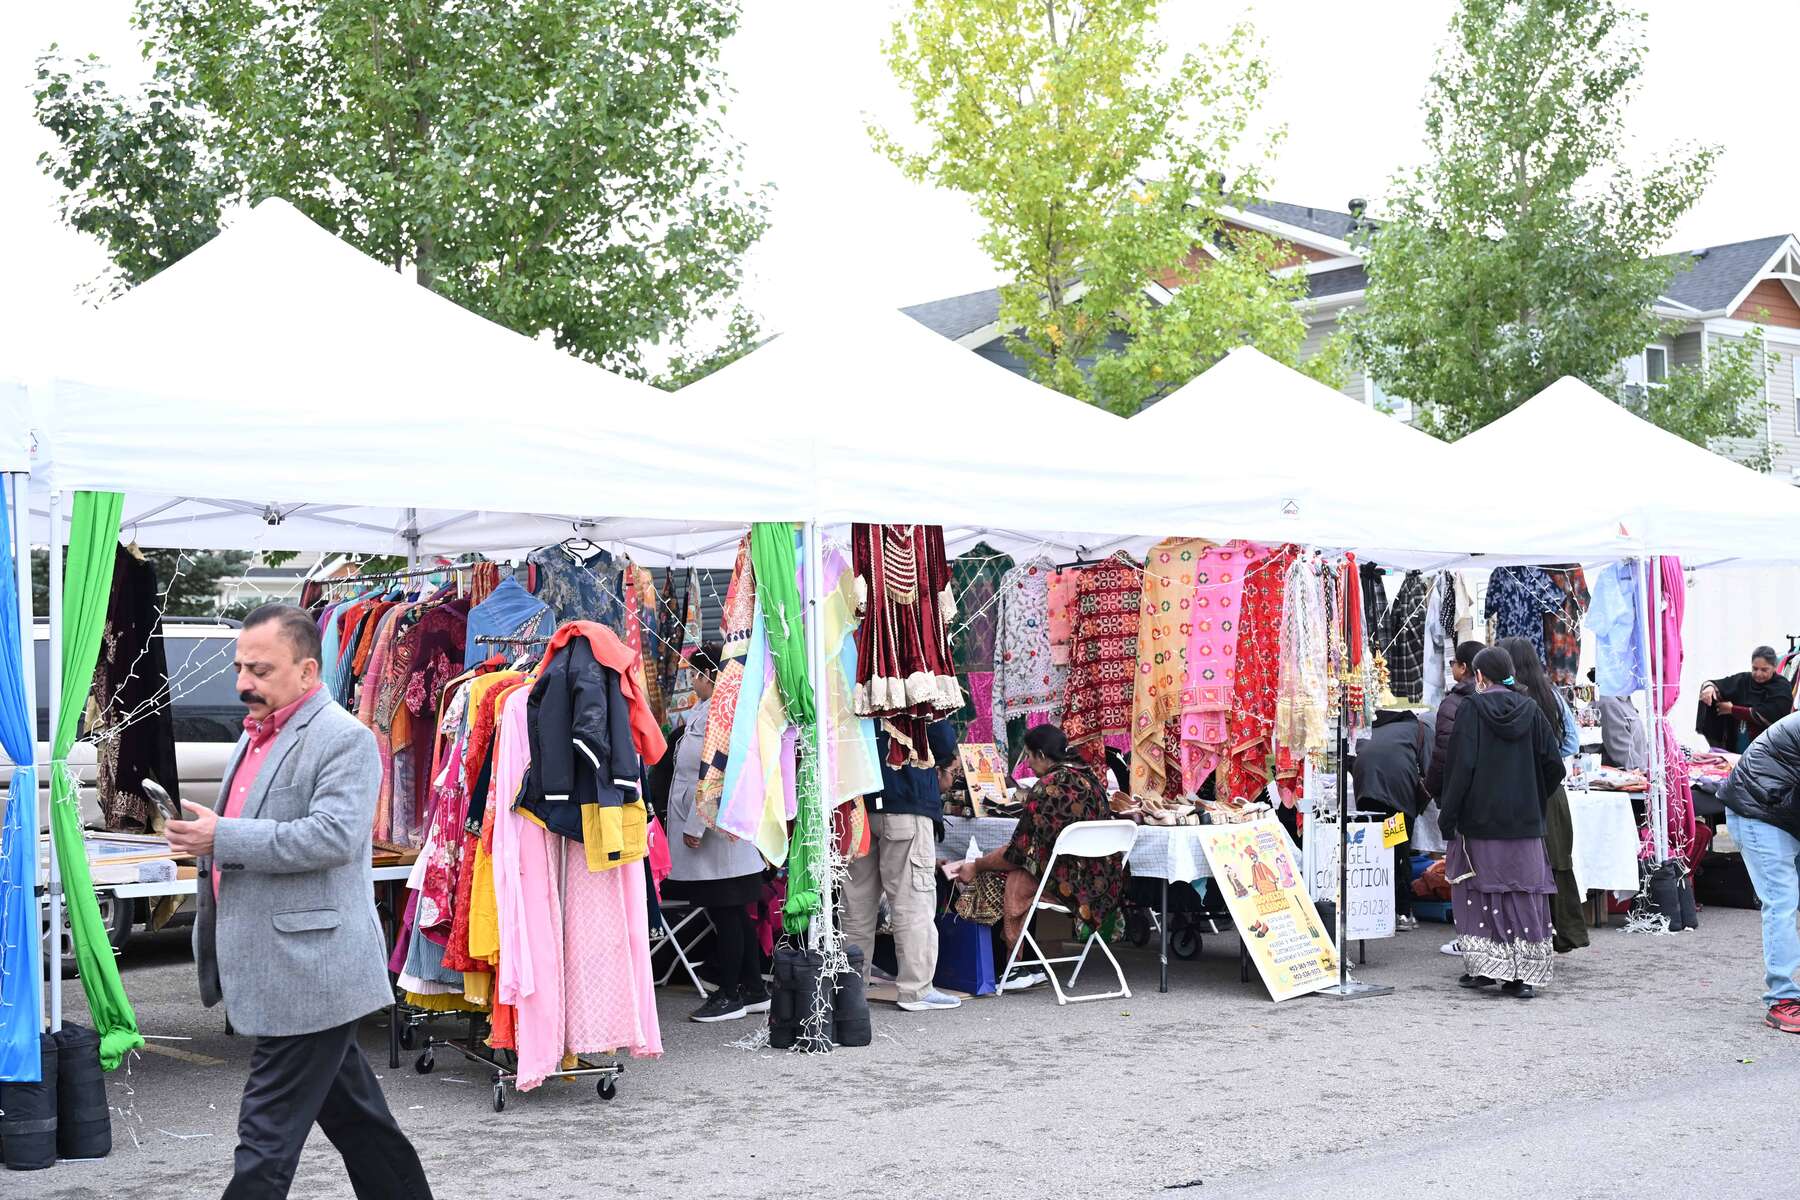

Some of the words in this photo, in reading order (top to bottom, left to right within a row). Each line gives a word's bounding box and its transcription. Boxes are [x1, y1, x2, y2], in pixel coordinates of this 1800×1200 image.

[1384, 823, 1405, 838] SALE
[1316, 867, 1389, 889] COCTION
[1257, 898, 1290, 915] FASHION
